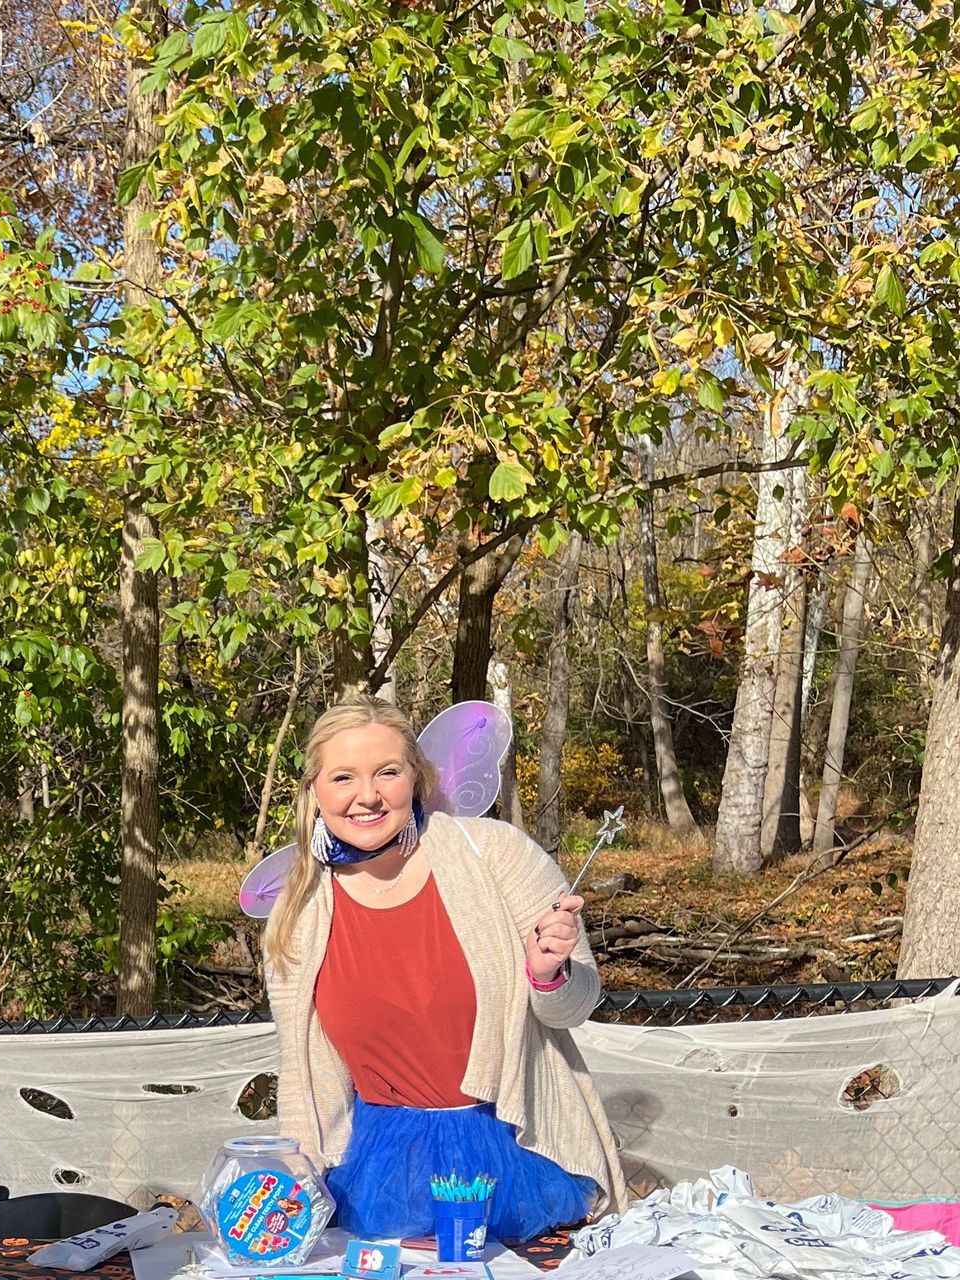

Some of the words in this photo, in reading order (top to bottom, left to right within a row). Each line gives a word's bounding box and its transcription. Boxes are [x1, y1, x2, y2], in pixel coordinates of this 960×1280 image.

[243, 1232, 254, 1244] THE
[251, 1215, 265, 1233] CLEAN
[262, 1199, 275, 1216] TEETH
[273, 1184, 285, 1199] POPS
